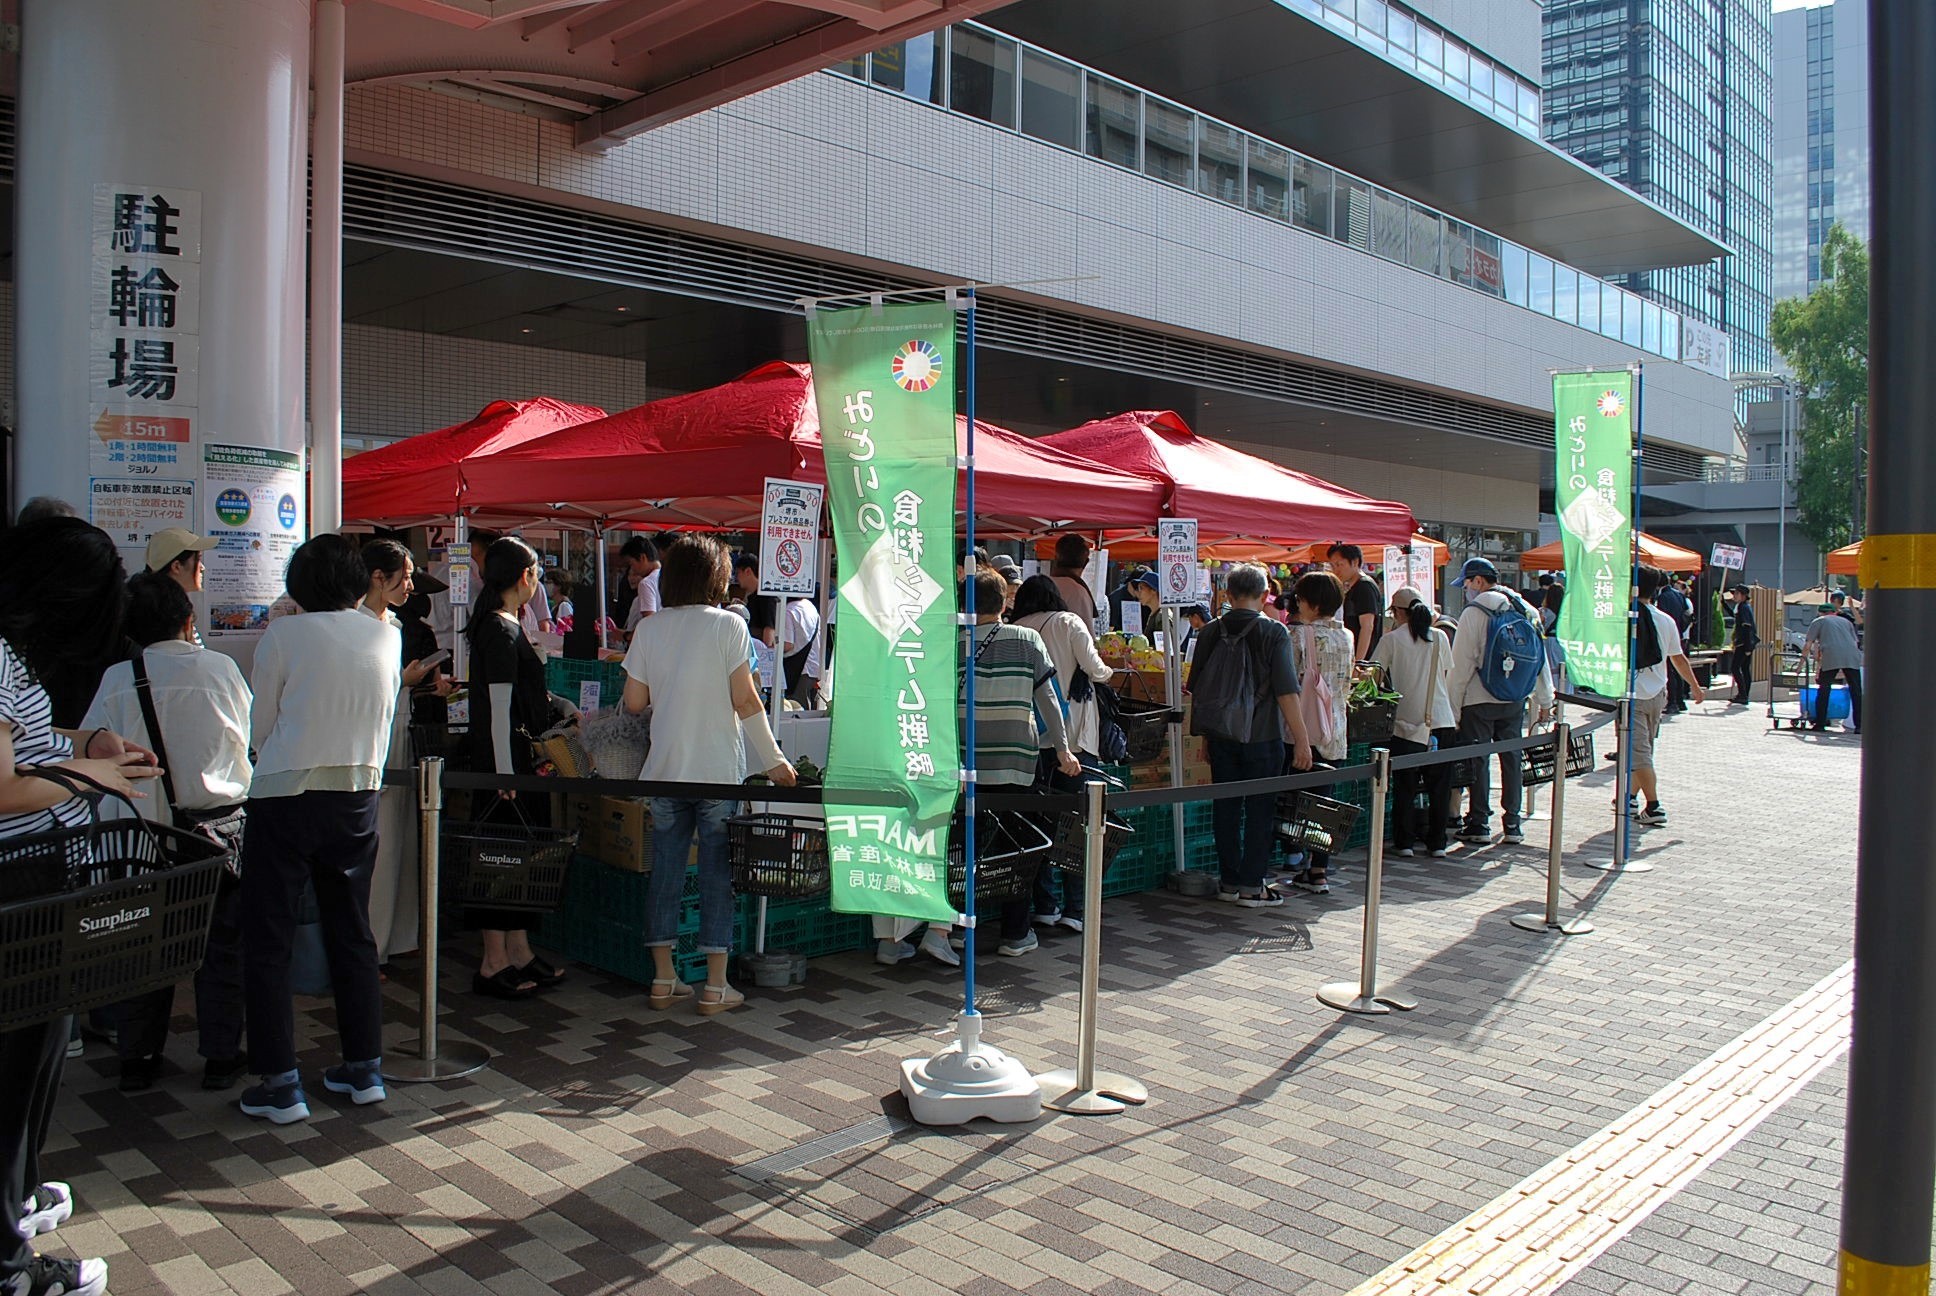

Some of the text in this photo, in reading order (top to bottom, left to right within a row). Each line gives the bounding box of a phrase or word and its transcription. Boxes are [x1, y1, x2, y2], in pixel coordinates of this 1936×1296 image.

[107, 193, 181, 401] 駐輪場
[124, 421, 167, 437] 15m
[127, 465, 158, 474] ジョルノ
[93, 484, 192, 495] 自転車等放置禁止区域
[768, 515, 814, 526] プレミアム商品券は
[767, 526, 812, 540] 利用できません
[1162, 554, 1194, 562] 利用できません
[479, 852, 522, 865] Sunplaza
[980, 867, 1012, 878] Sunplaza
[79, 906, 151, 933] Sunplaza
